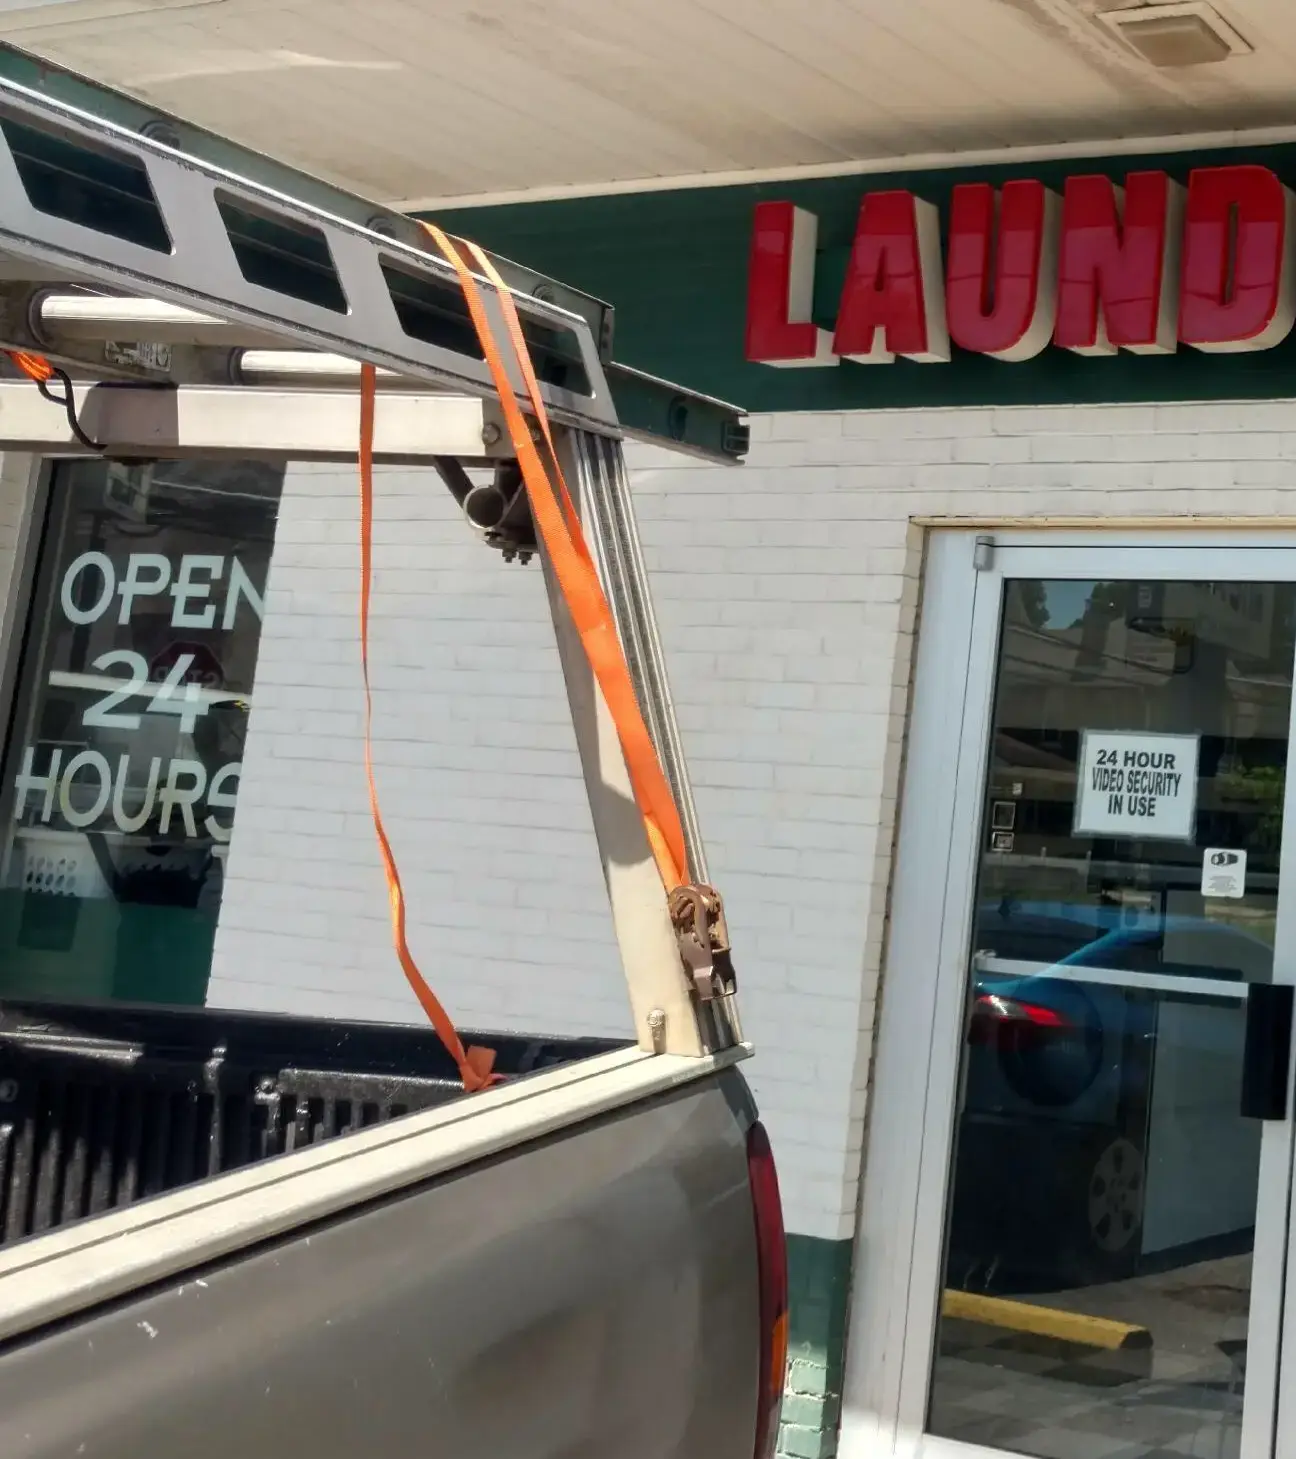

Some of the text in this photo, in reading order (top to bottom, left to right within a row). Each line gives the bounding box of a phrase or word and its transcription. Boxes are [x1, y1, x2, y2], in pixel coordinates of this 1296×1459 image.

[61, 551, 266, 630] OPEN
[82, 650, 209, 734] 24
[1092, 767, 1183, 797] VIDEO SECURITY
[1096, 749, 1176, 769] 24 HOUR
[14, 746, 242, 842] HOURS
[1108, 794, 1156, 817] IN USE
